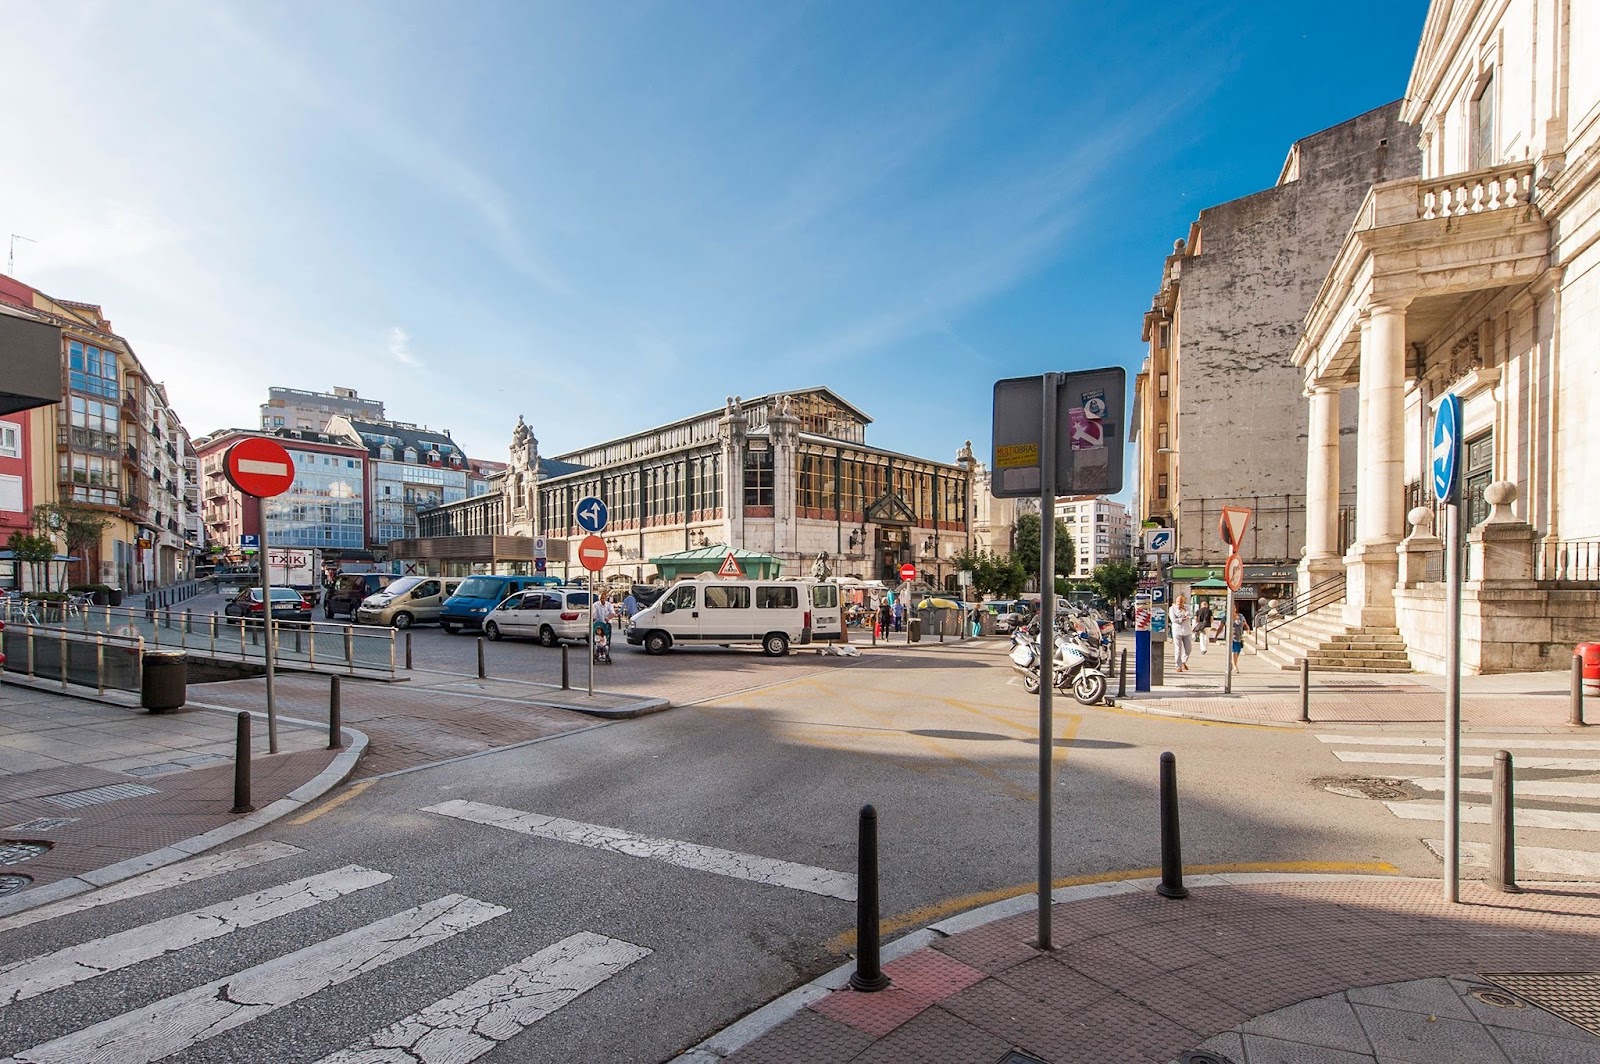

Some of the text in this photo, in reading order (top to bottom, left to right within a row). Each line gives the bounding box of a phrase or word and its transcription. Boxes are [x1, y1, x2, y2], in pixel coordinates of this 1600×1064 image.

[997, 444, 1037, 455] MULTIOBRAS
[245, 535, 254, 543] P
[269, 555, 306, 564] TXIKI
[1153, 589, 1163, 601] P
